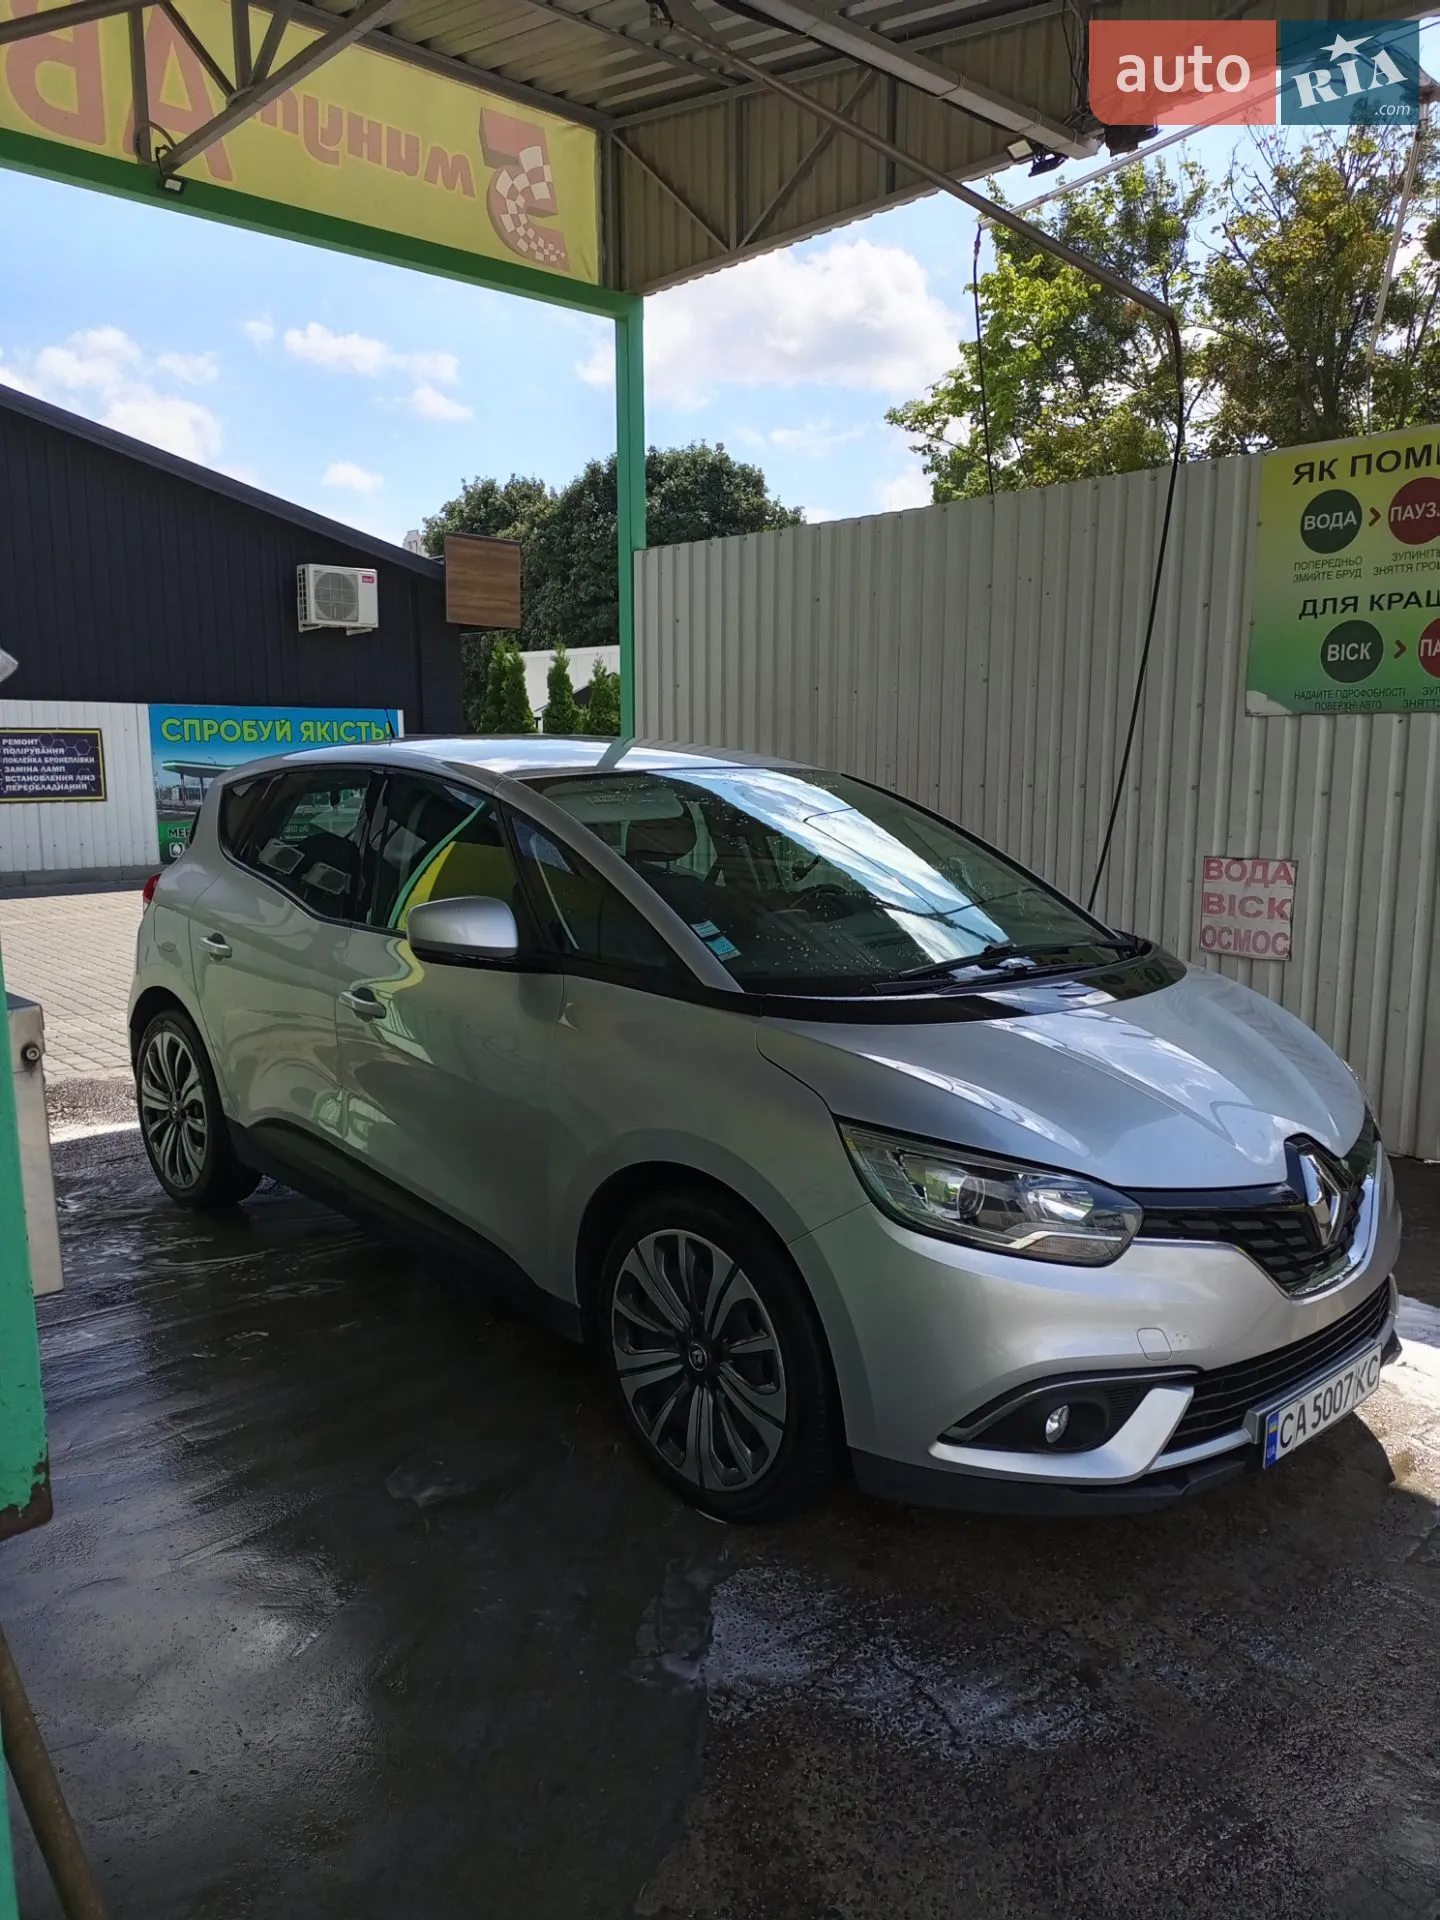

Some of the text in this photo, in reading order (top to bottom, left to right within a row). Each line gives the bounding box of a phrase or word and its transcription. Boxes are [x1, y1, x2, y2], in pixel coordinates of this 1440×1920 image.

[1291, 441, 1440, 486] ЯК ПОМ
[1303, 510, 1357, 532] ВОДА
[1294, 556, 1363, 571] ПОПЕРЕДНЬО
[1372, 563, 1413, 576] ЗНЯТТЯ
[1293, 568, 1362, 583] ЗМИЙТЕ БРУД
[1298, 595, 1359, 620] ДЛЯ
[1327, 641, 1372, 662] ВІСК
[2, 738, 39, 746] РЕМОНТ
[161, 717, 292, 744] СПРОБУЙ
[3, 747, 65, 755] ПОЛІРУВАННЯ
[1205, 858, 1294, 888] ВОДА
[1203, 892, 1292, 921] ВІСК
[1201, 924, 1290, 956] ОСМОС
[1279, 1355, 1379, 1448] CA 5007 KC
